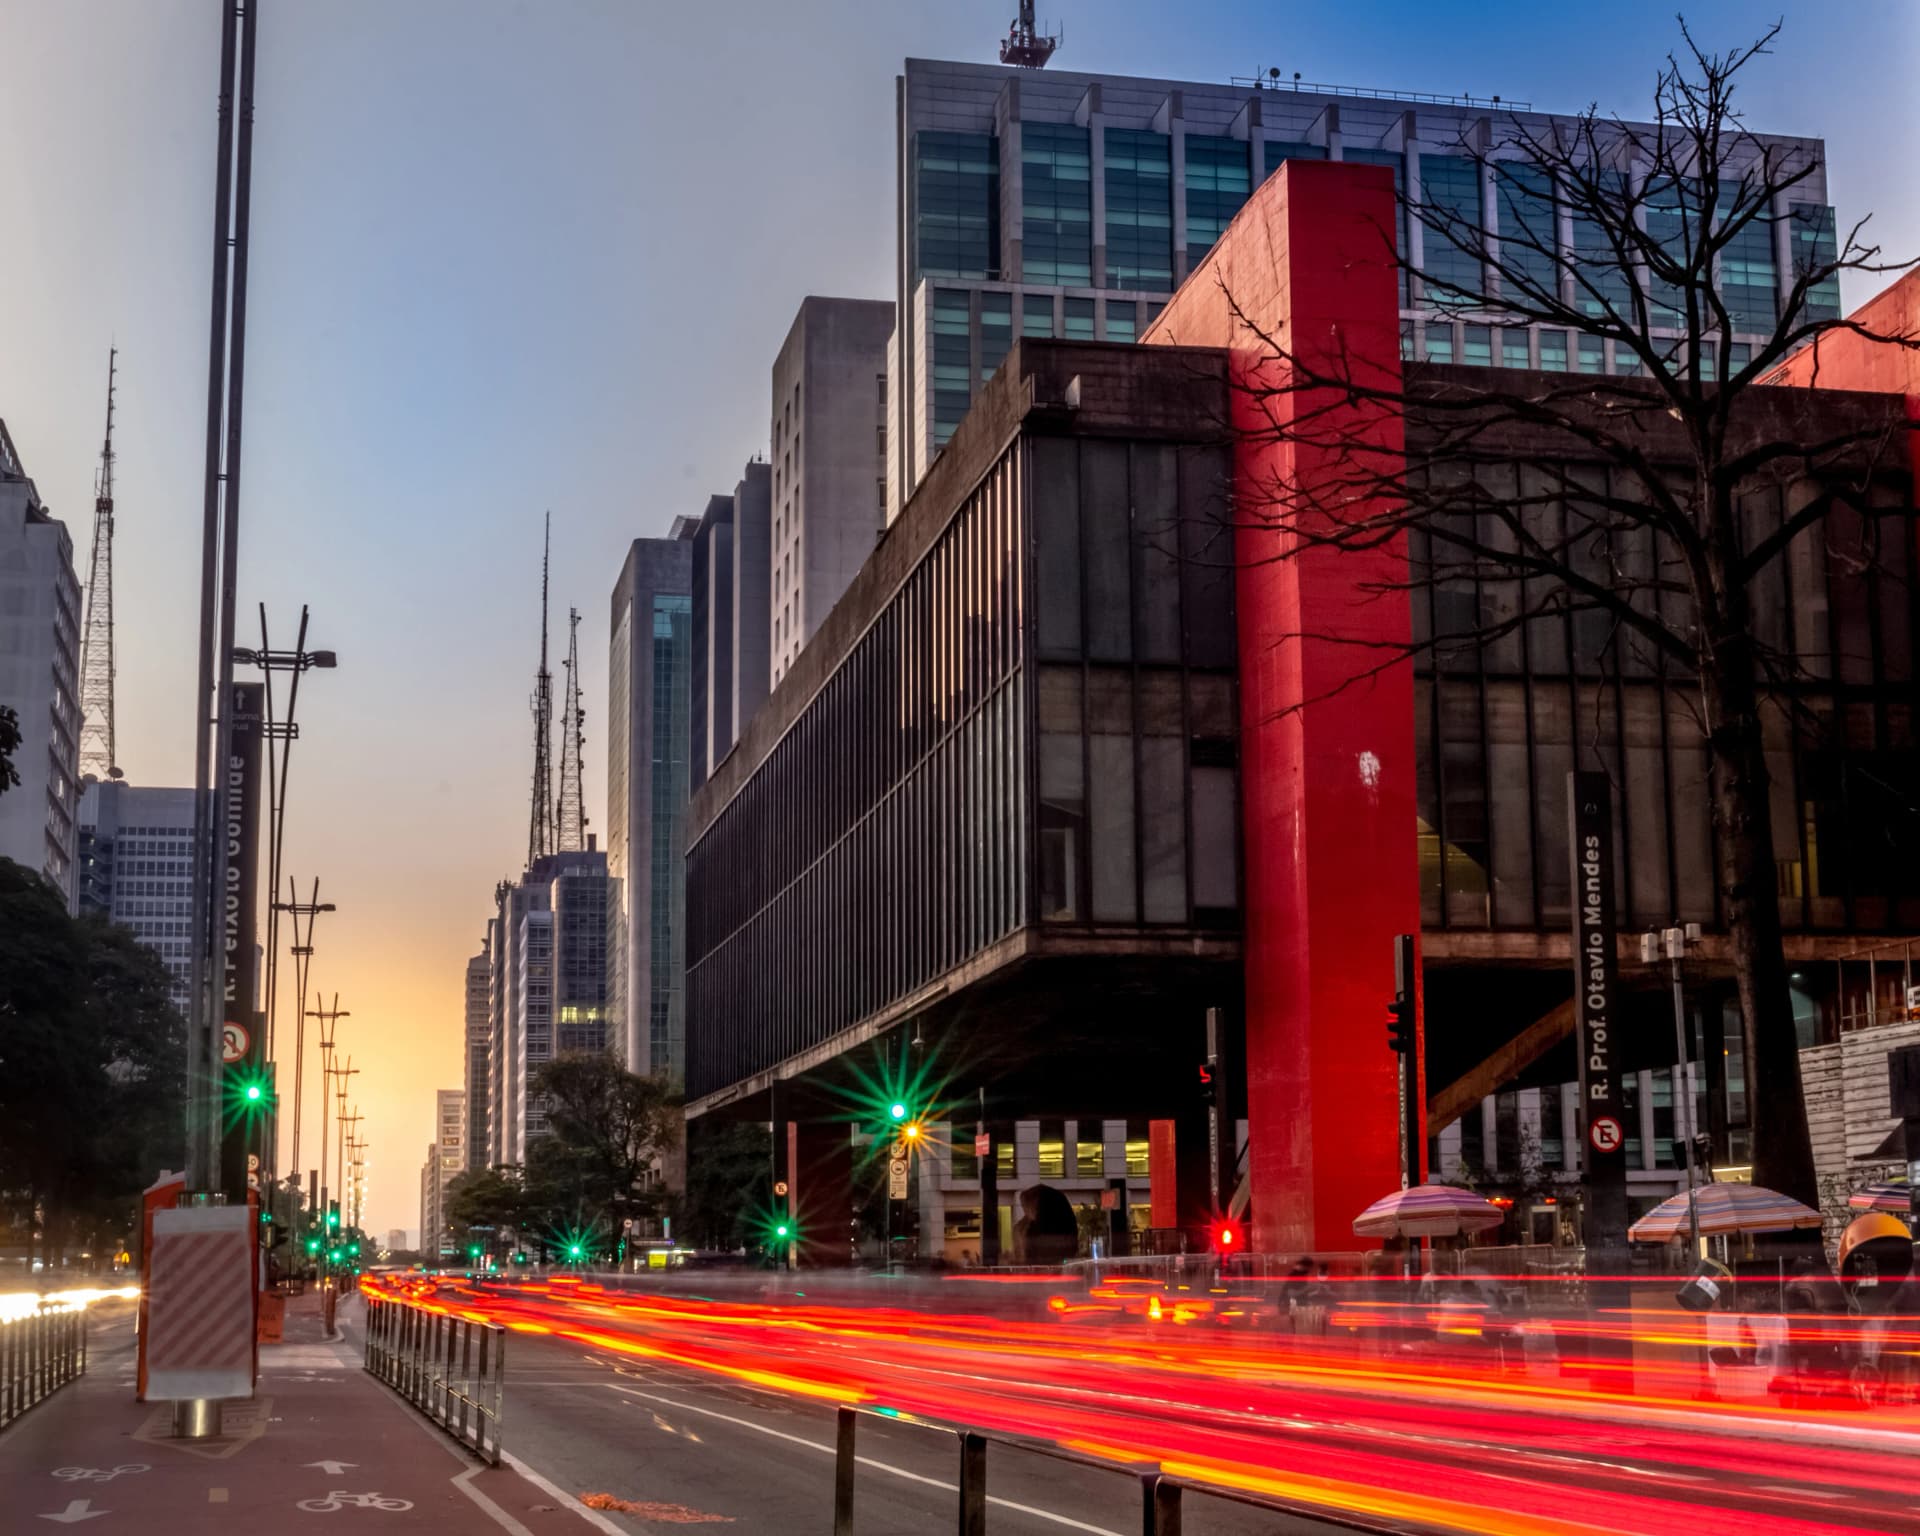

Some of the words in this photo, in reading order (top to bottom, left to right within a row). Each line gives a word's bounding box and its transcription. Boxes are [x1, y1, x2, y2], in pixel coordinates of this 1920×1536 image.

[1582, 836, 1602, 925] Mendes
[1586, 932, 1606, 1010] Otavio
[1588, 1015, 1608, 1071] Prof.
[1590, 1078, 1608, 1100] R.
